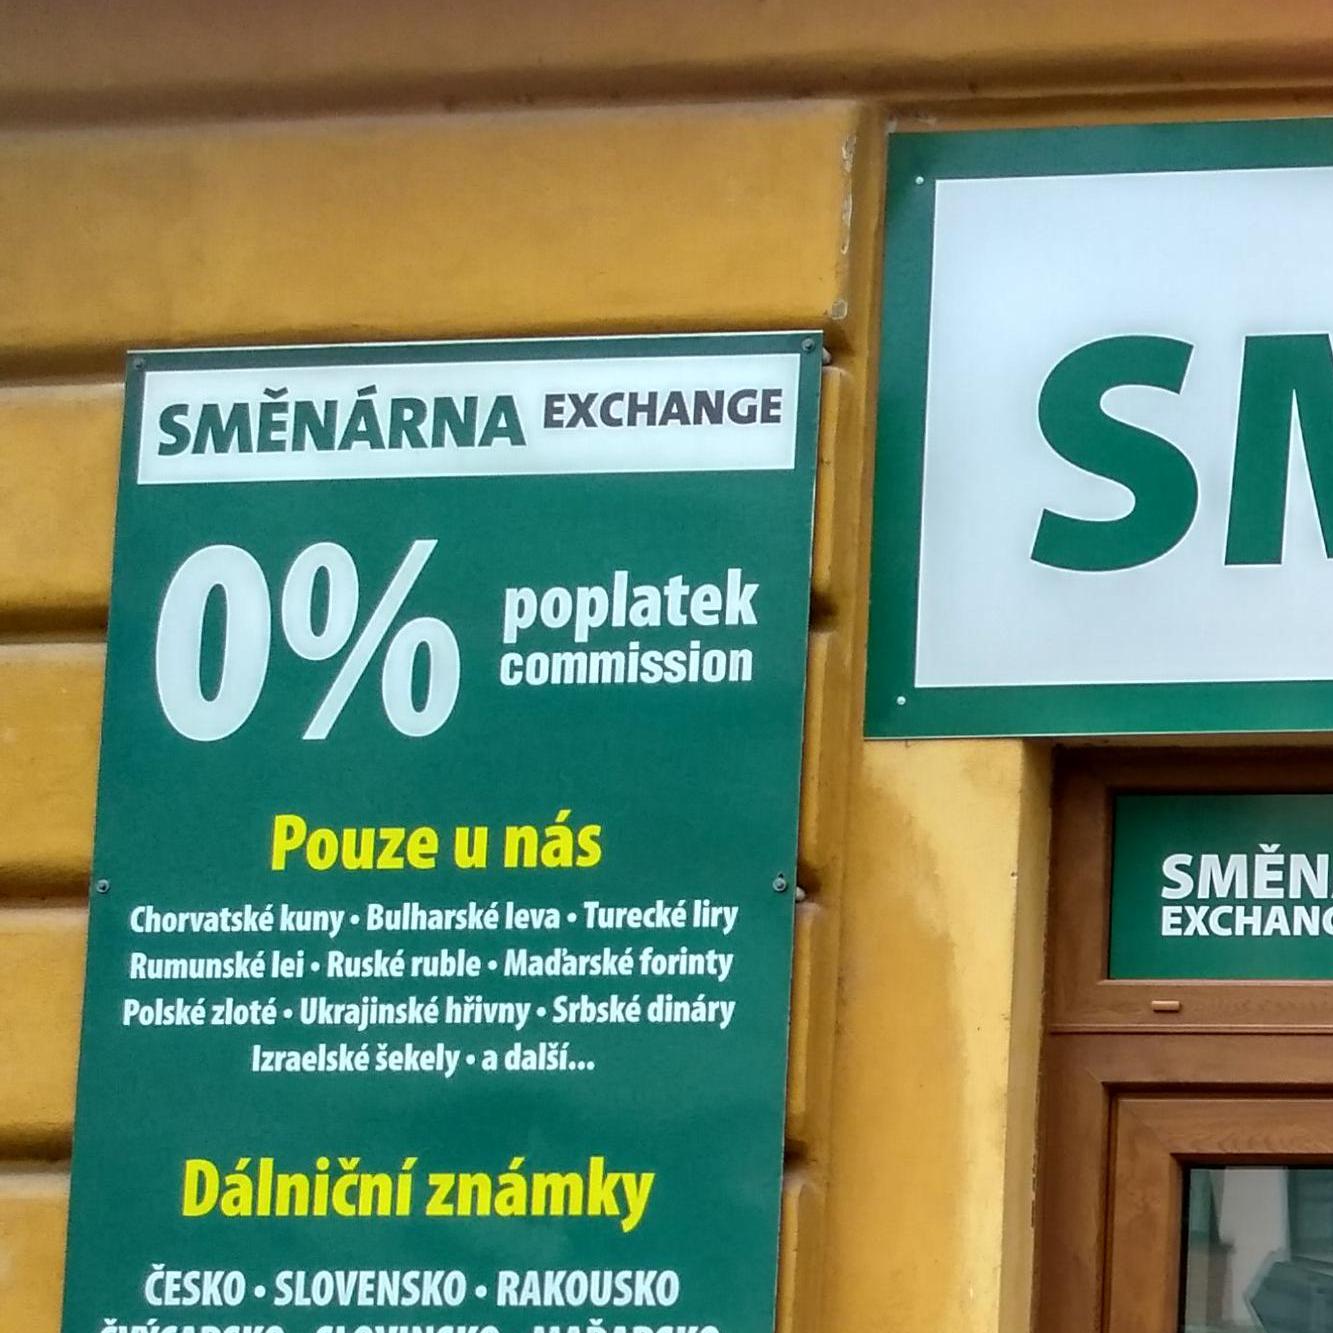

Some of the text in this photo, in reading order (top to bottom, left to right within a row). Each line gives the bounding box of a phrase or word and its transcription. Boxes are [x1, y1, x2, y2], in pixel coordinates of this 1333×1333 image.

[158, 385, 782, 455] SMĚNÁRNA EXCHANGE
[503, 568, 759, 643] poplatek
[156, 540, 460, 741] 0%
[500, 640, 752, 685] commission
[272, 810, 601, 870] Pouze u nás
[131, 899, 738, 938] Chorvatské kuny Bulharské leva Turecké liry
[130, 947, 733, 982] Rumunské lei Ruské ruble Maďarské forinty
[123, 994, 735, 1031] Polské zloté Ukrajinské hřivny Srbské dináry
[253, 1043, 369, 1071] Izraelské
[375, 1043, 460, 1078] šekely
[482, 1050, 497, 1070] a
[183, 1157, 655, 1232] Dálniční známky
[145, 1264, 679, 1306] ČESKO SLOVENSKO RAKOUSKO
